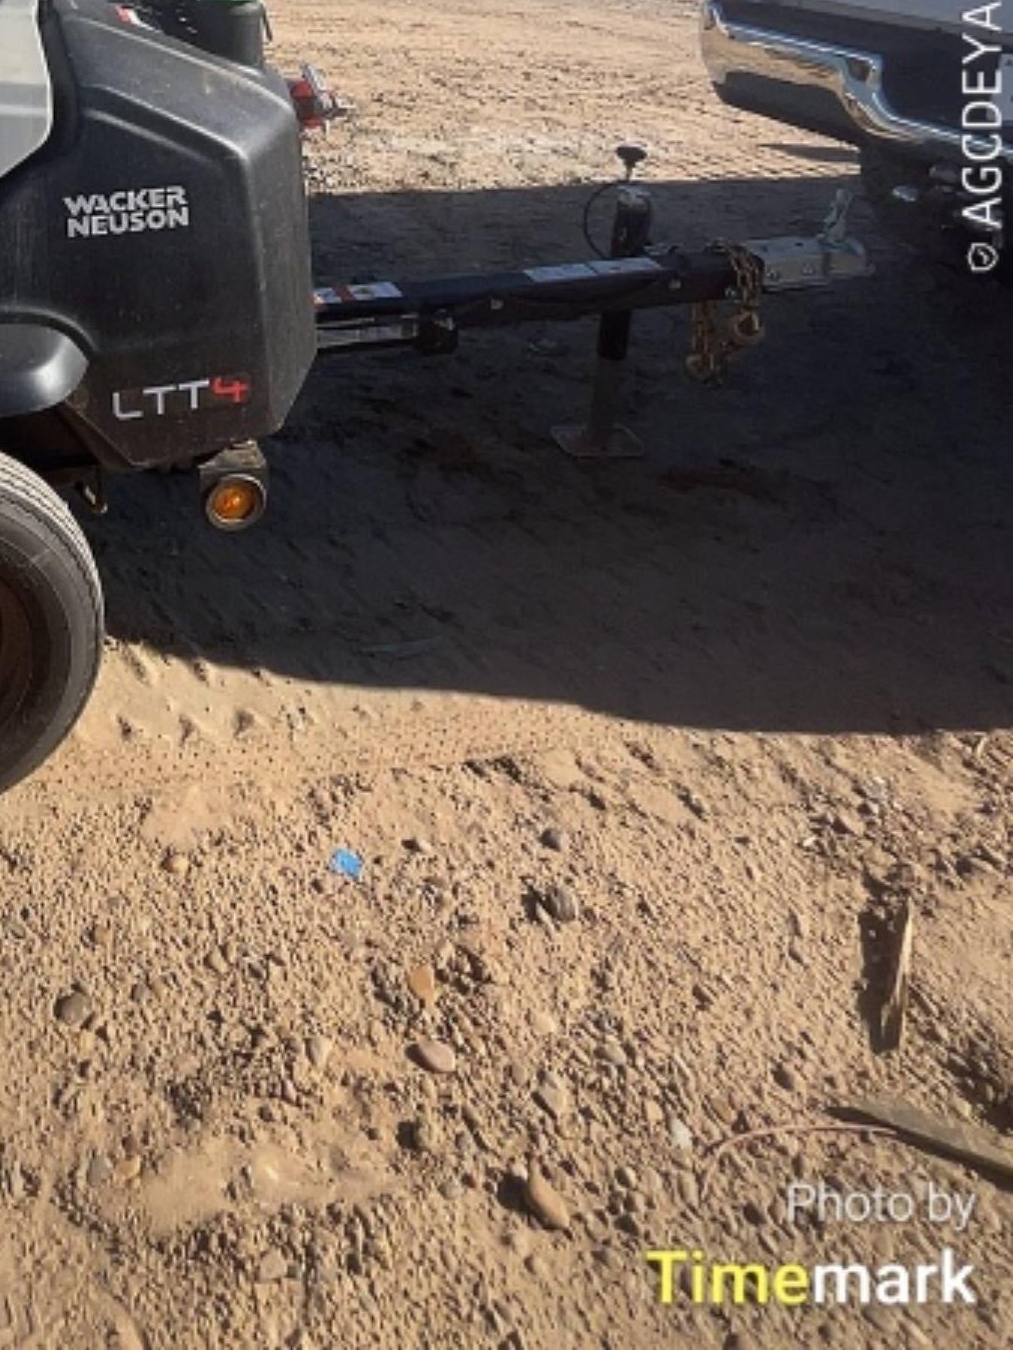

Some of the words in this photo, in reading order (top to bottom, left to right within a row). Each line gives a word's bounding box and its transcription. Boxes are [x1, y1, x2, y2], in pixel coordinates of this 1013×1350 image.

[63, 185, 188, 216] WACKER
[67, 206, 190, 239] NEUSON
[111, 377, 249, 421] LTT4
